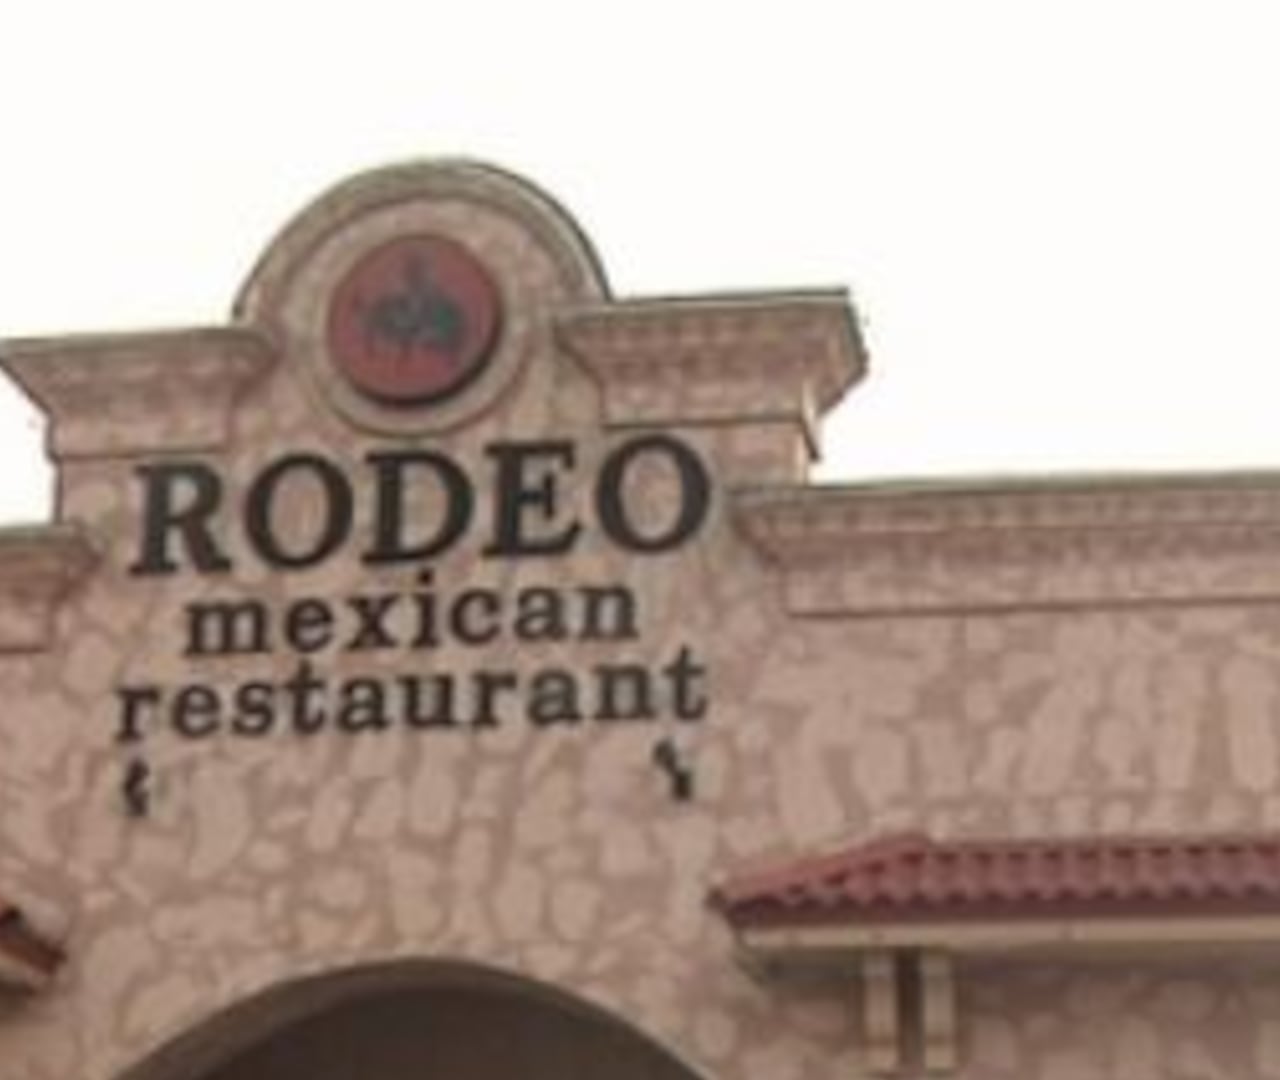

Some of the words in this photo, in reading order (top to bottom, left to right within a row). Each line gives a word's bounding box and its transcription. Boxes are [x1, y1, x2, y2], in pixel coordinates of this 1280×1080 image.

[128, 434, 711, 577] RODEO
[183, 571, 639, 657] mexican
[115, 646, 708, 743] restaurant
